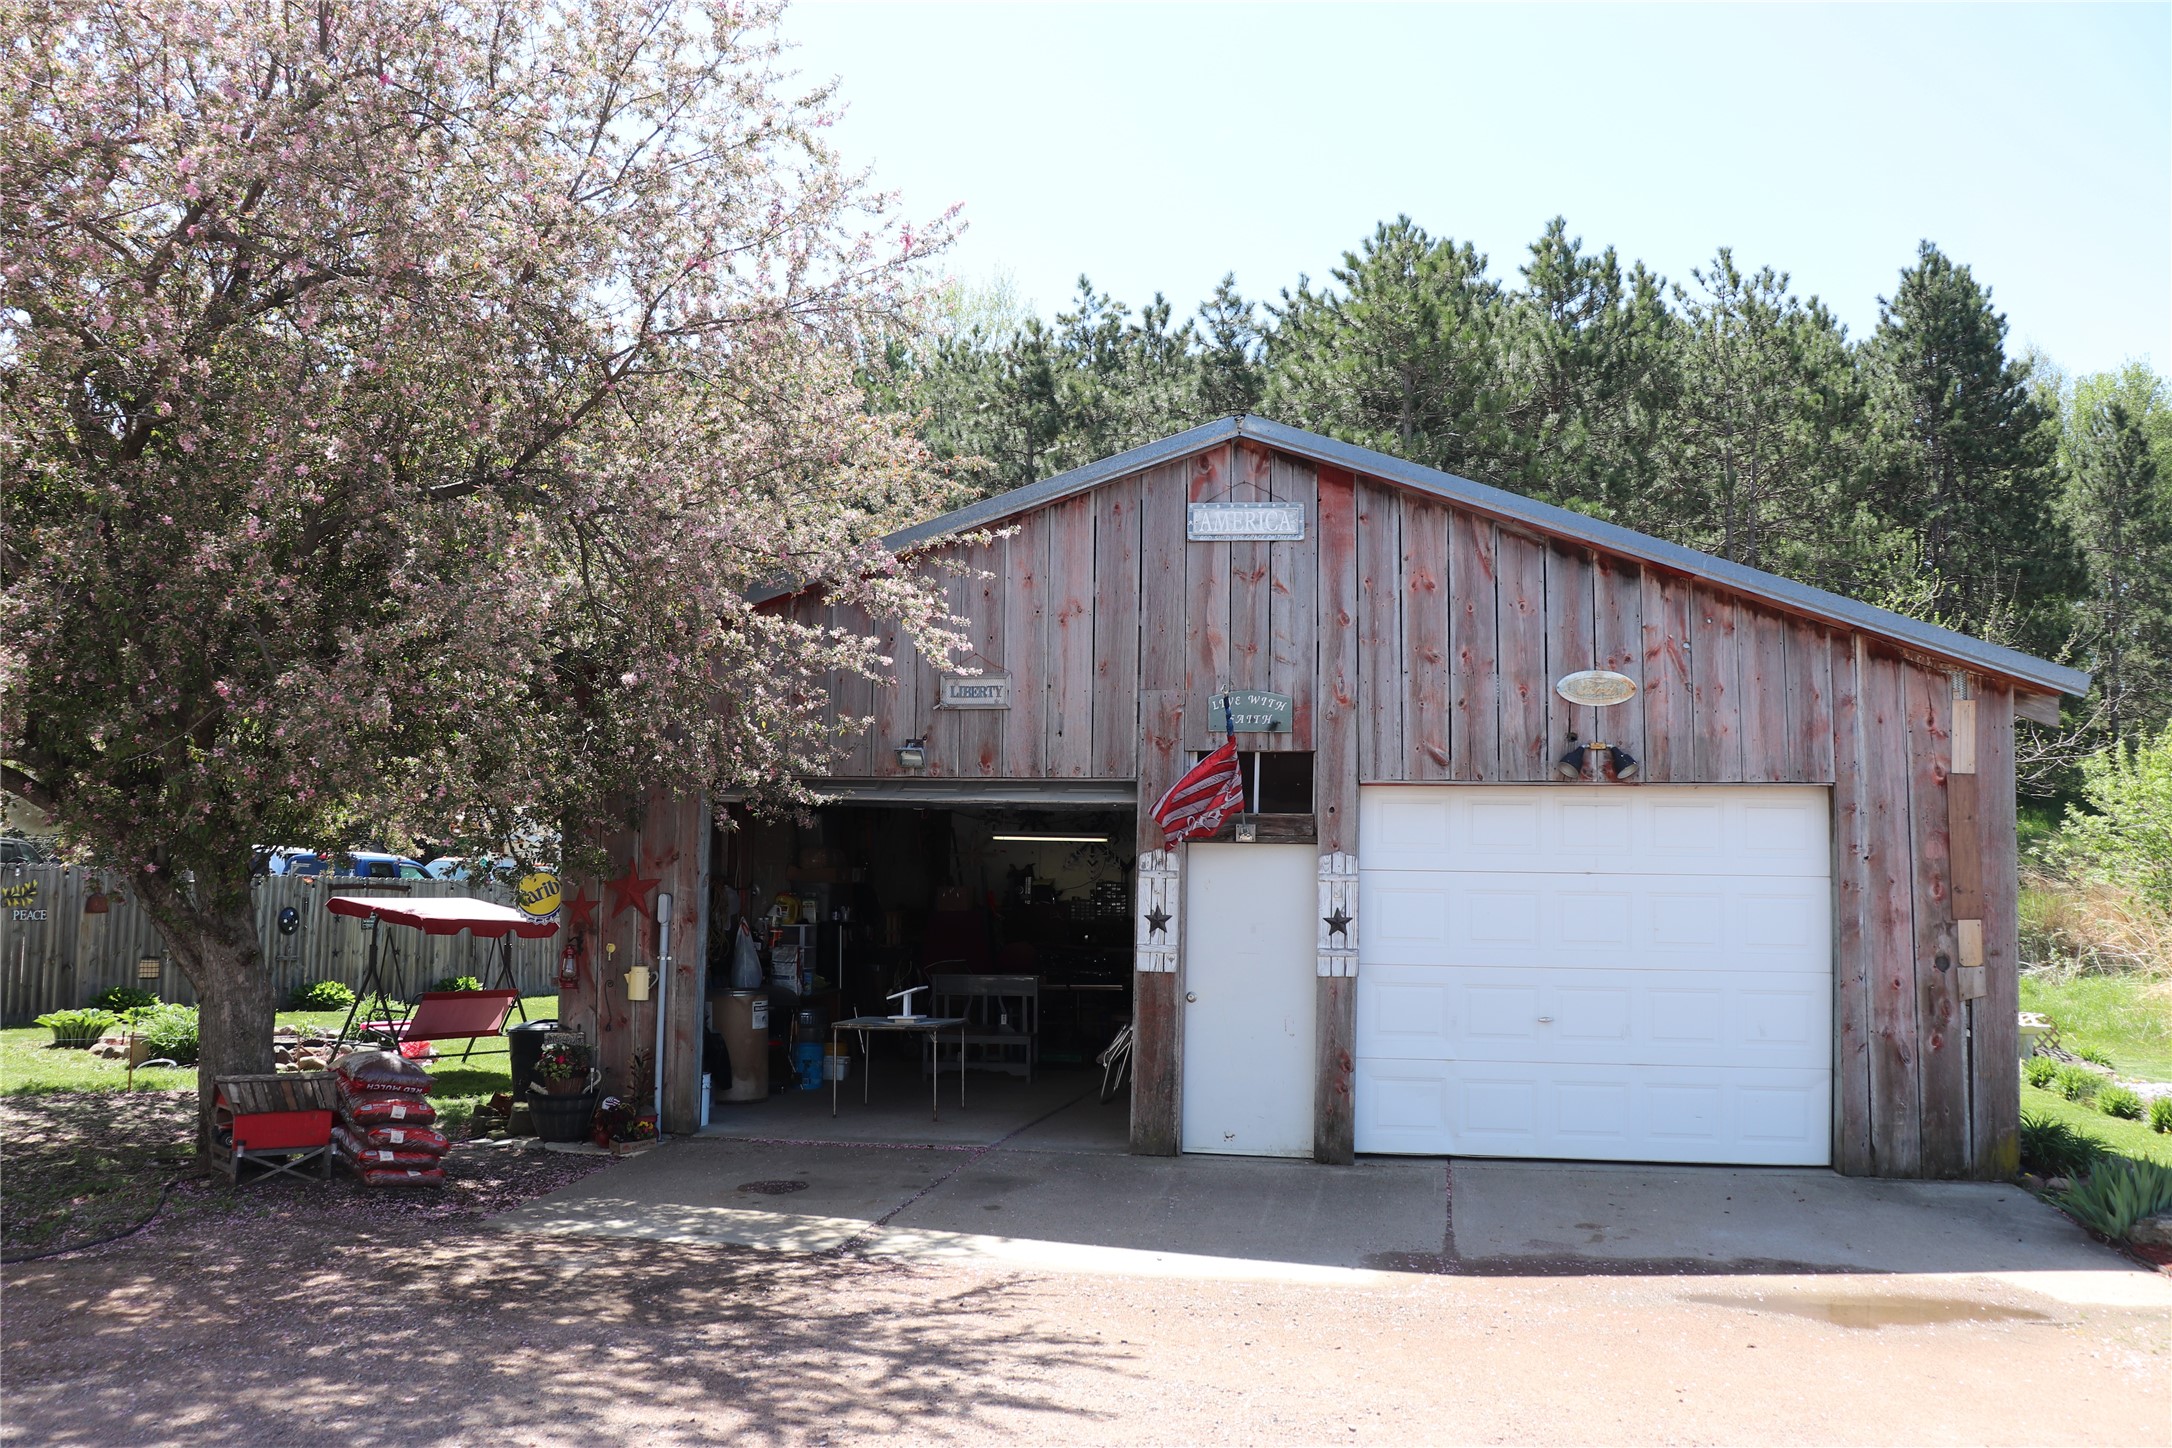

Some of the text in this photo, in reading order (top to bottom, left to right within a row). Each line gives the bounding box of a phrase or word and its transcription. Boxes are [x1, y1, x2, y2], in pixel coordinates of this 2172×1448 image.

[1199, 511, 1292, 532] AMERICA
[950, 685, 1004, 698] LIBERTY
[1212, 694, 1287, 712] LIVE WITH
[521, 880, 560, 906] arib
[12, 909, 47, 921] PEACE
[366, 1083, 423, 1094] RED MULCH
